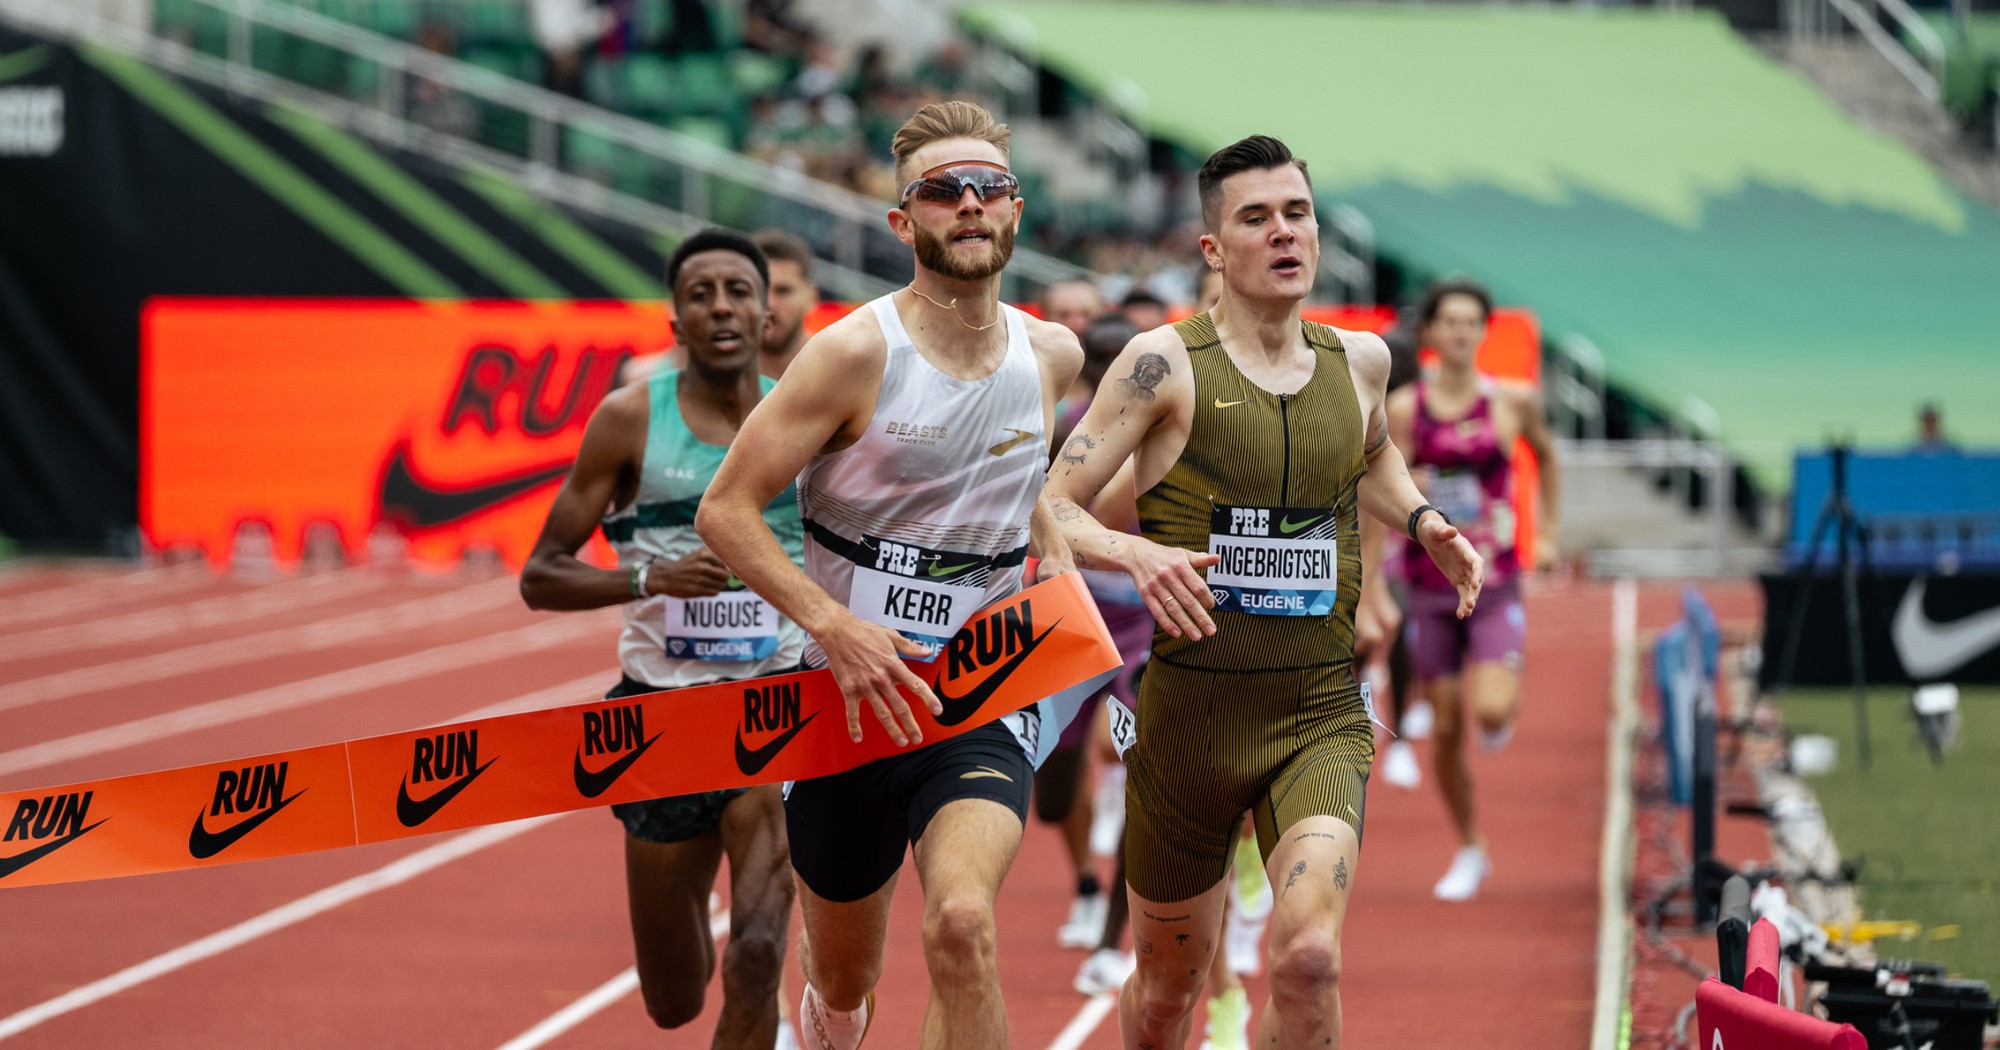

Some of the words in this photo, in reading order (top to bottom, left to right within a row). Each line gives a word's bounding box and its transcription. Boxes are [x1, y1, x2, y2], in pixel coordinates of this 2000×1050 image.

[886, 421, 948, 439] BEASTS
[896, 437, 917, 445] TRACK
[664, 466, 696, 481] OAC
[1230, 507, 1270, 537] PRE
[875, 540, 921, 577] PRE
[1214, 544, 1331, 580] INGEBRIGTSEN
[683, 600, 764, 628] NUGUSE
[883, 584, 953, 627] KERR
[1240, 593, 1305, 611] EUGENE
[694, 641, 754, 657] EUGENE
[947, 598, 1034, 682] RUN
[743, 682, 801, 734] RUN
[1112, 706, 1132, 747] 15
[582, 703, 645, 757] RUN
[411, 728, 478, 785] RUN
[209, 761, 289, 817] RUN
[2, 790, 94, 843] RUN
